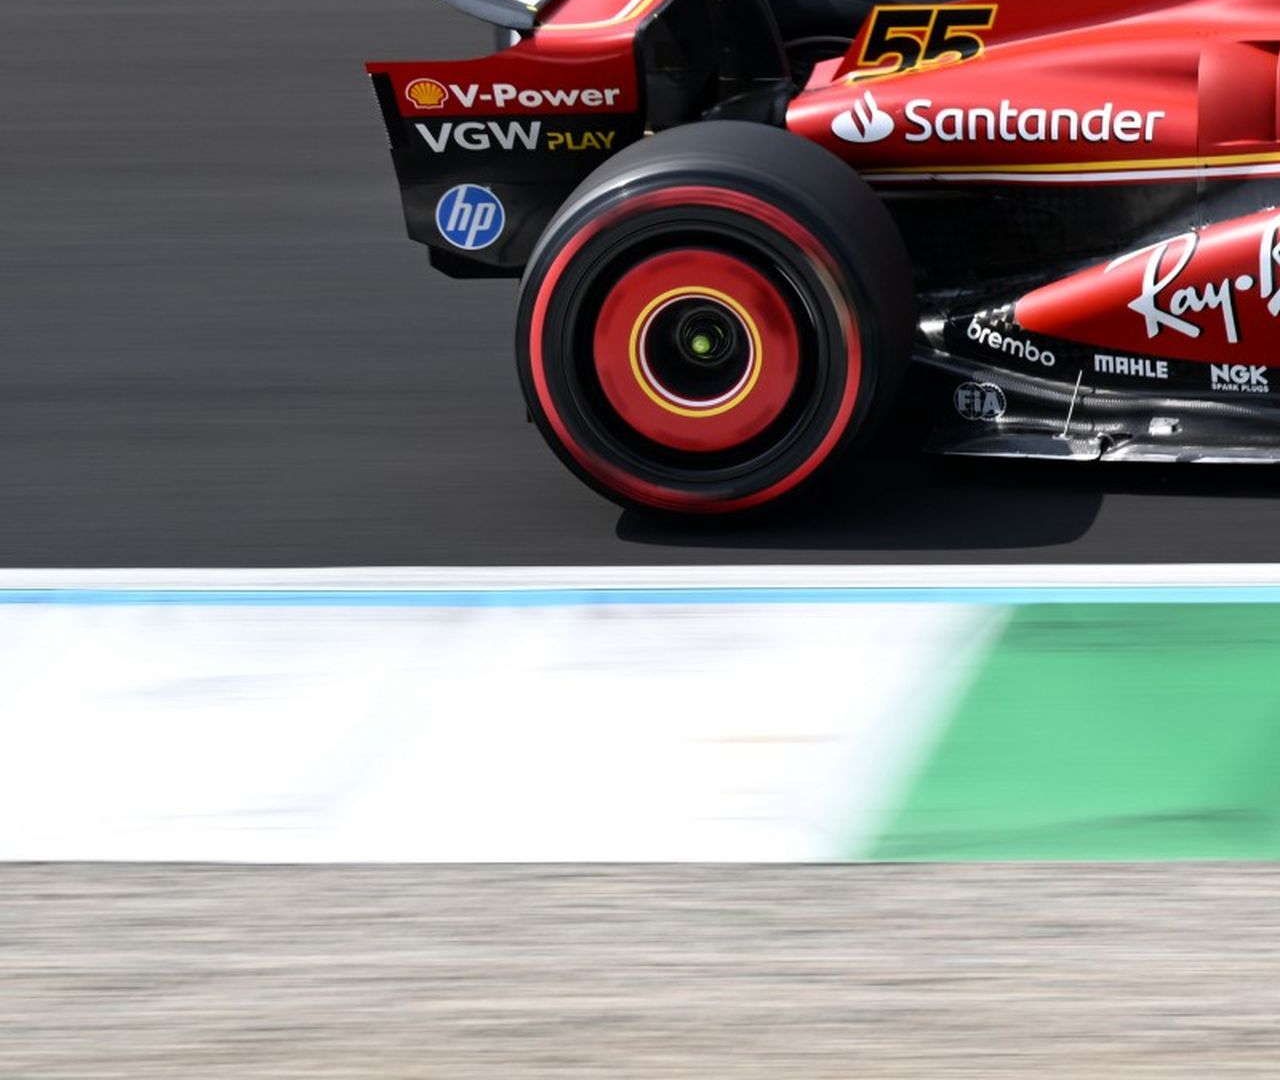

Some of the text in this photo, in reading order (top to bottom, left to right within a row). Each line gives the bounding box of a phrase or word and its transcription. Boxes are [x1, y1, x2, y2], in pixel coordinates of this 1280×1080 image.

[846, 3, 999, 86] 55
[449, 83, 621, 108] V-Power
[904, 99, 1166, 142] Santander
[415, 121, 615, 153] VGW PLAY
[446, 186, 497, 248] hp
[966, 315, 1056, 367] brembo
[1094, 354, 1169, 378] MAHLE
[1210, 363, 1268, 385] NGK
[1211, 383, 1240, 392] SPARK
